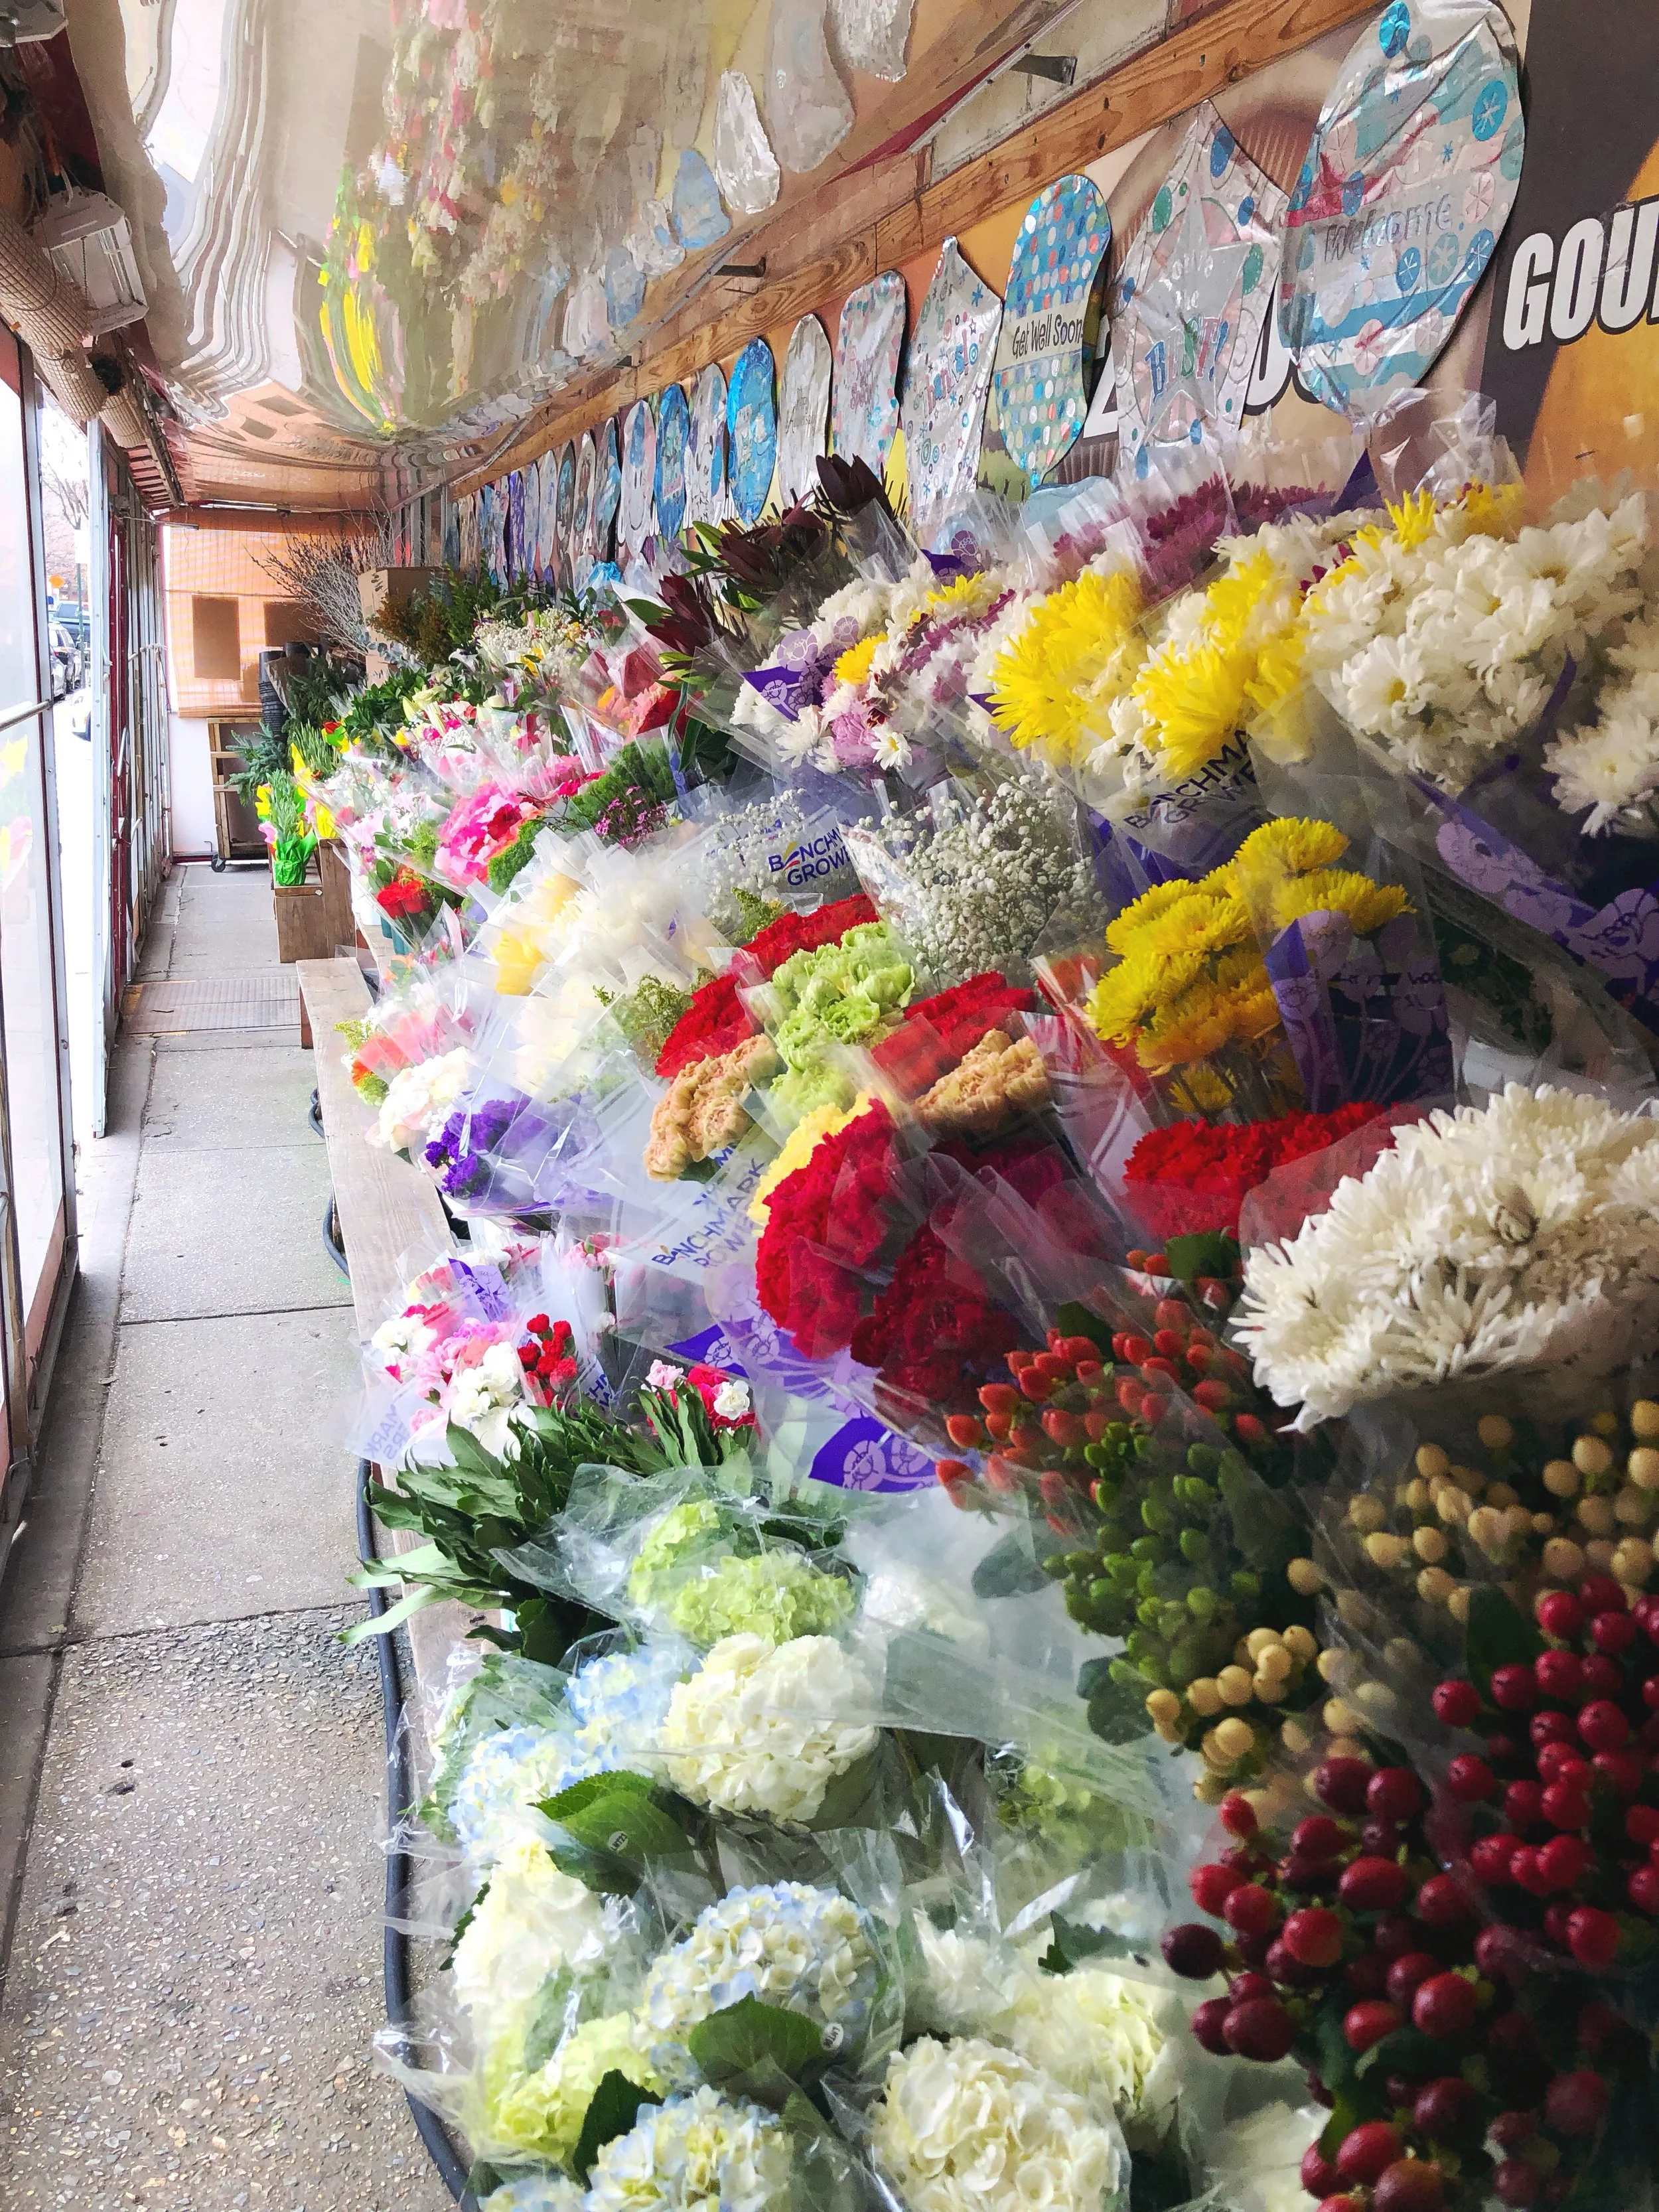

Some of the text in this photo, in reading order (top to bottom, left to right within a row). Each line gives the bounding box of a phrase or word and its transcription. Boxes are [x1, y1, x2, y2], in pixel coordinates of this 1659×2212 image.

[1503, 200, 1659, 350] GOU
[1012, 323, 1029, 360] Get
[1031, 313, 1052, 352] Well
[1144, 316, 1229, 404] BEST!
[768, 826, 843, 873] BENCHM
[787, 845, 850, 886] GROW
